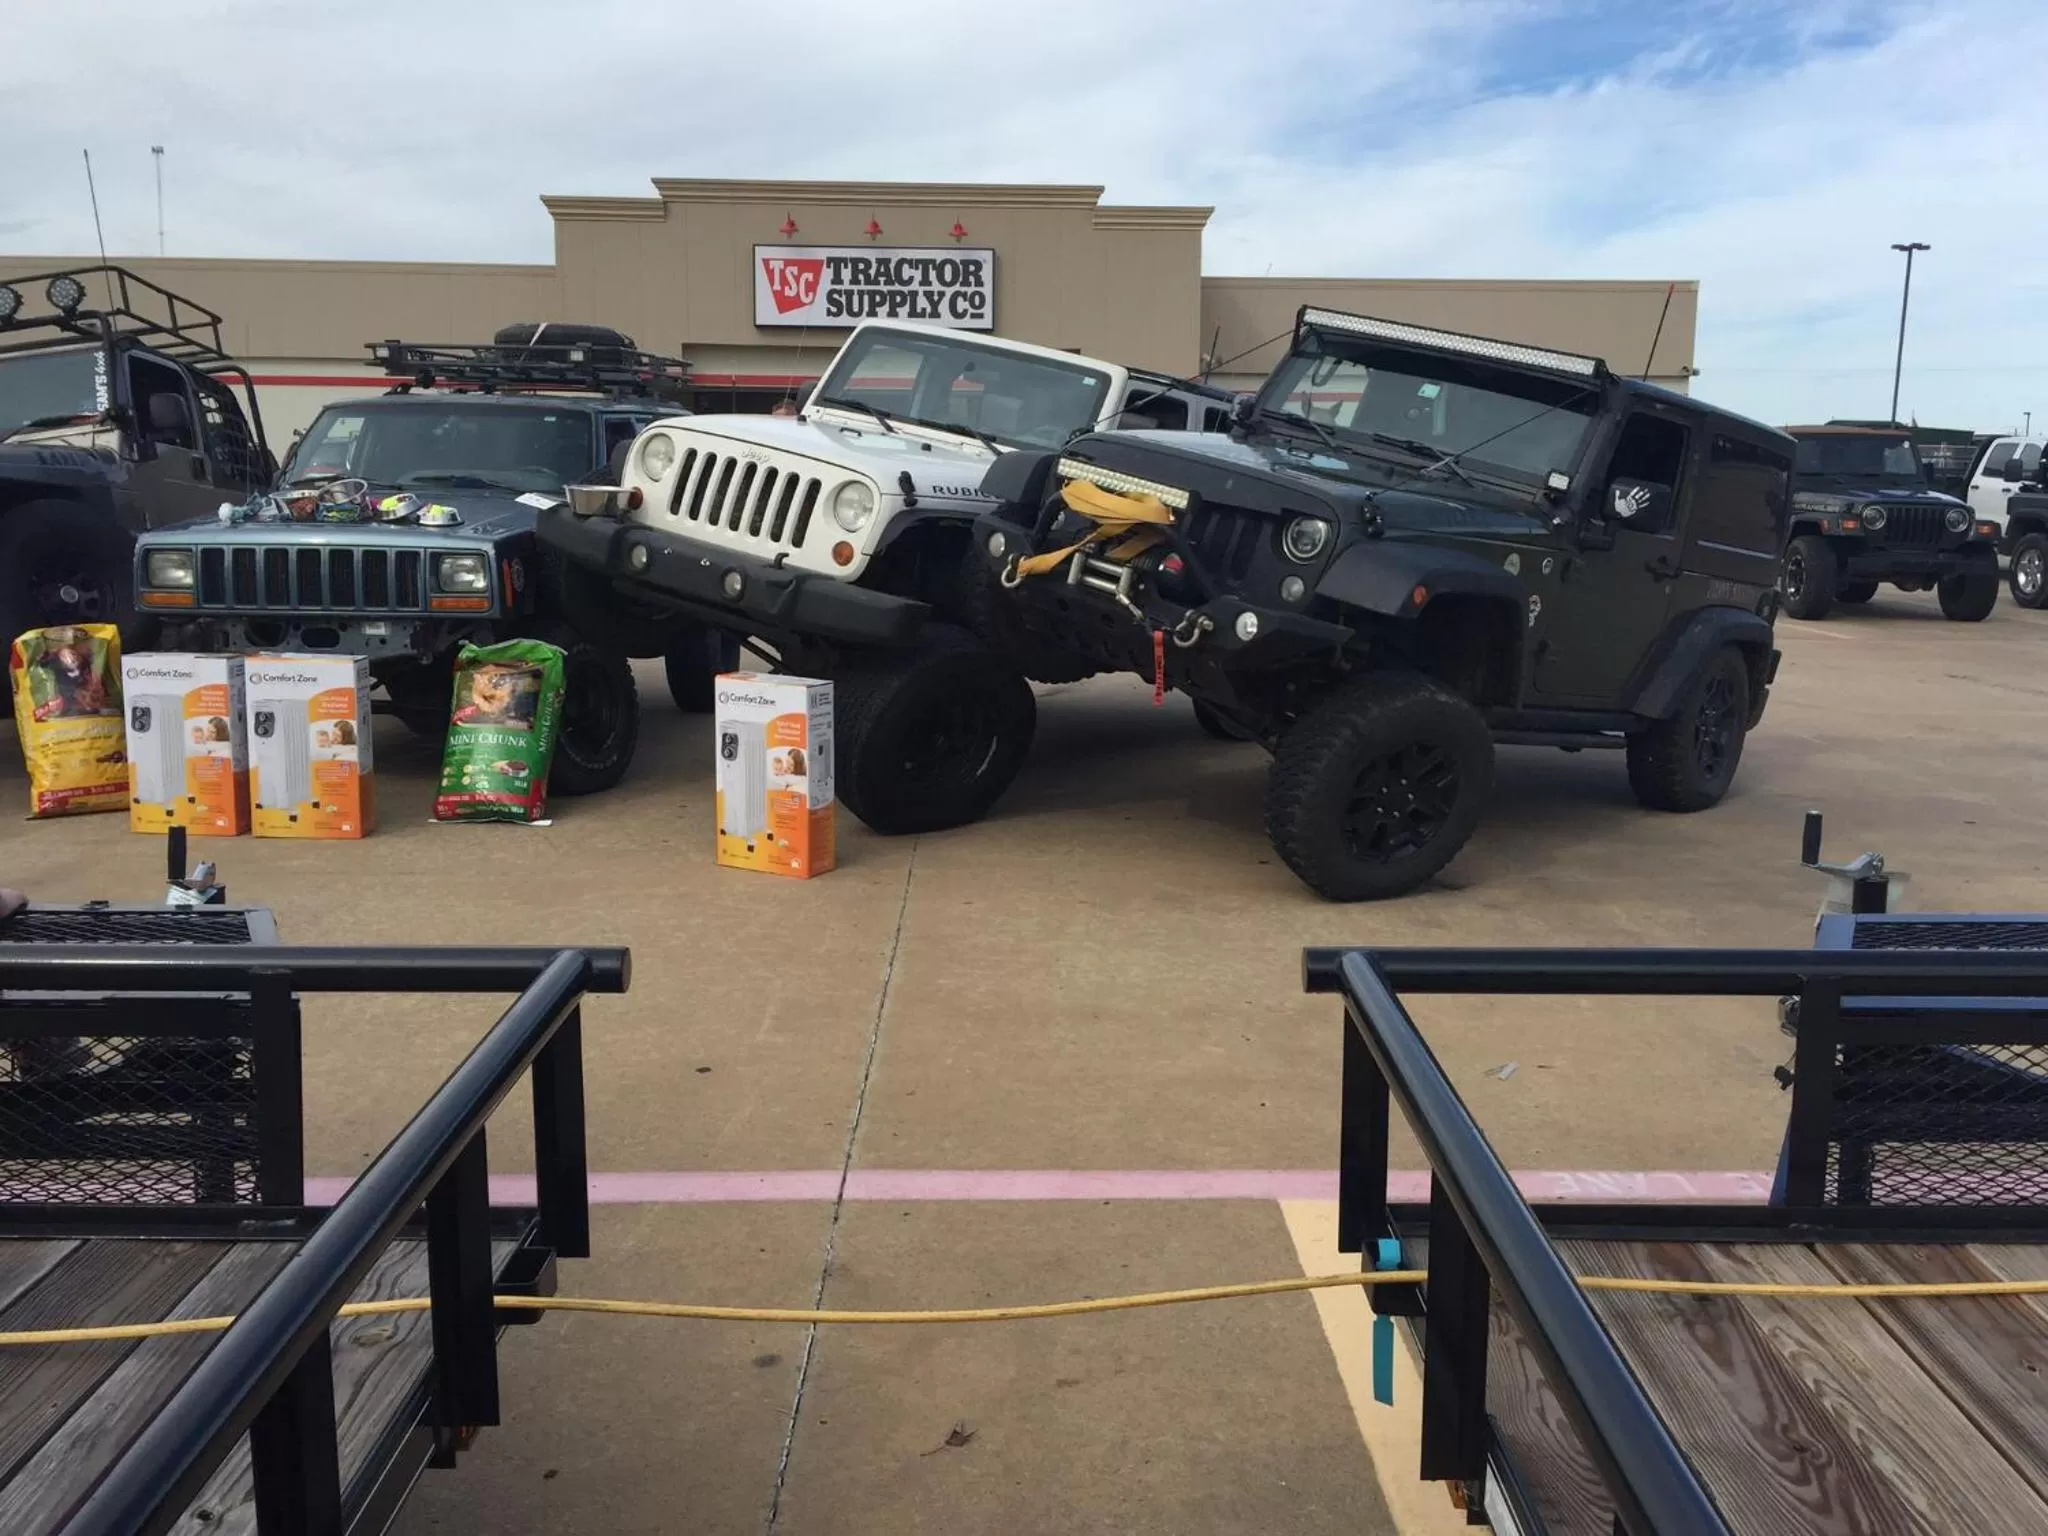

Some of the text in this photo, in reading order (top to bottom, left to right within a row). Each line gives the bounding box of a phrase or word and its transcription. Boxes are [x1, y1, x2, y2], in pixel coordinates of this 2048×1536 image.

[826, 256, 984, 287] TRACTOR
[769, 260, 814, 303] TSC
[826, 289, 946, 319] SUPPLY
[741, 447, 770, 464] Jeep
[139, 668, 193, 678] Comfort Zone
[263, 673, 317, 683] Comfort Zone
[730, 692, 776, 705] Comfort Zone
[450, 732, 527, 748] MINI CHUNK
